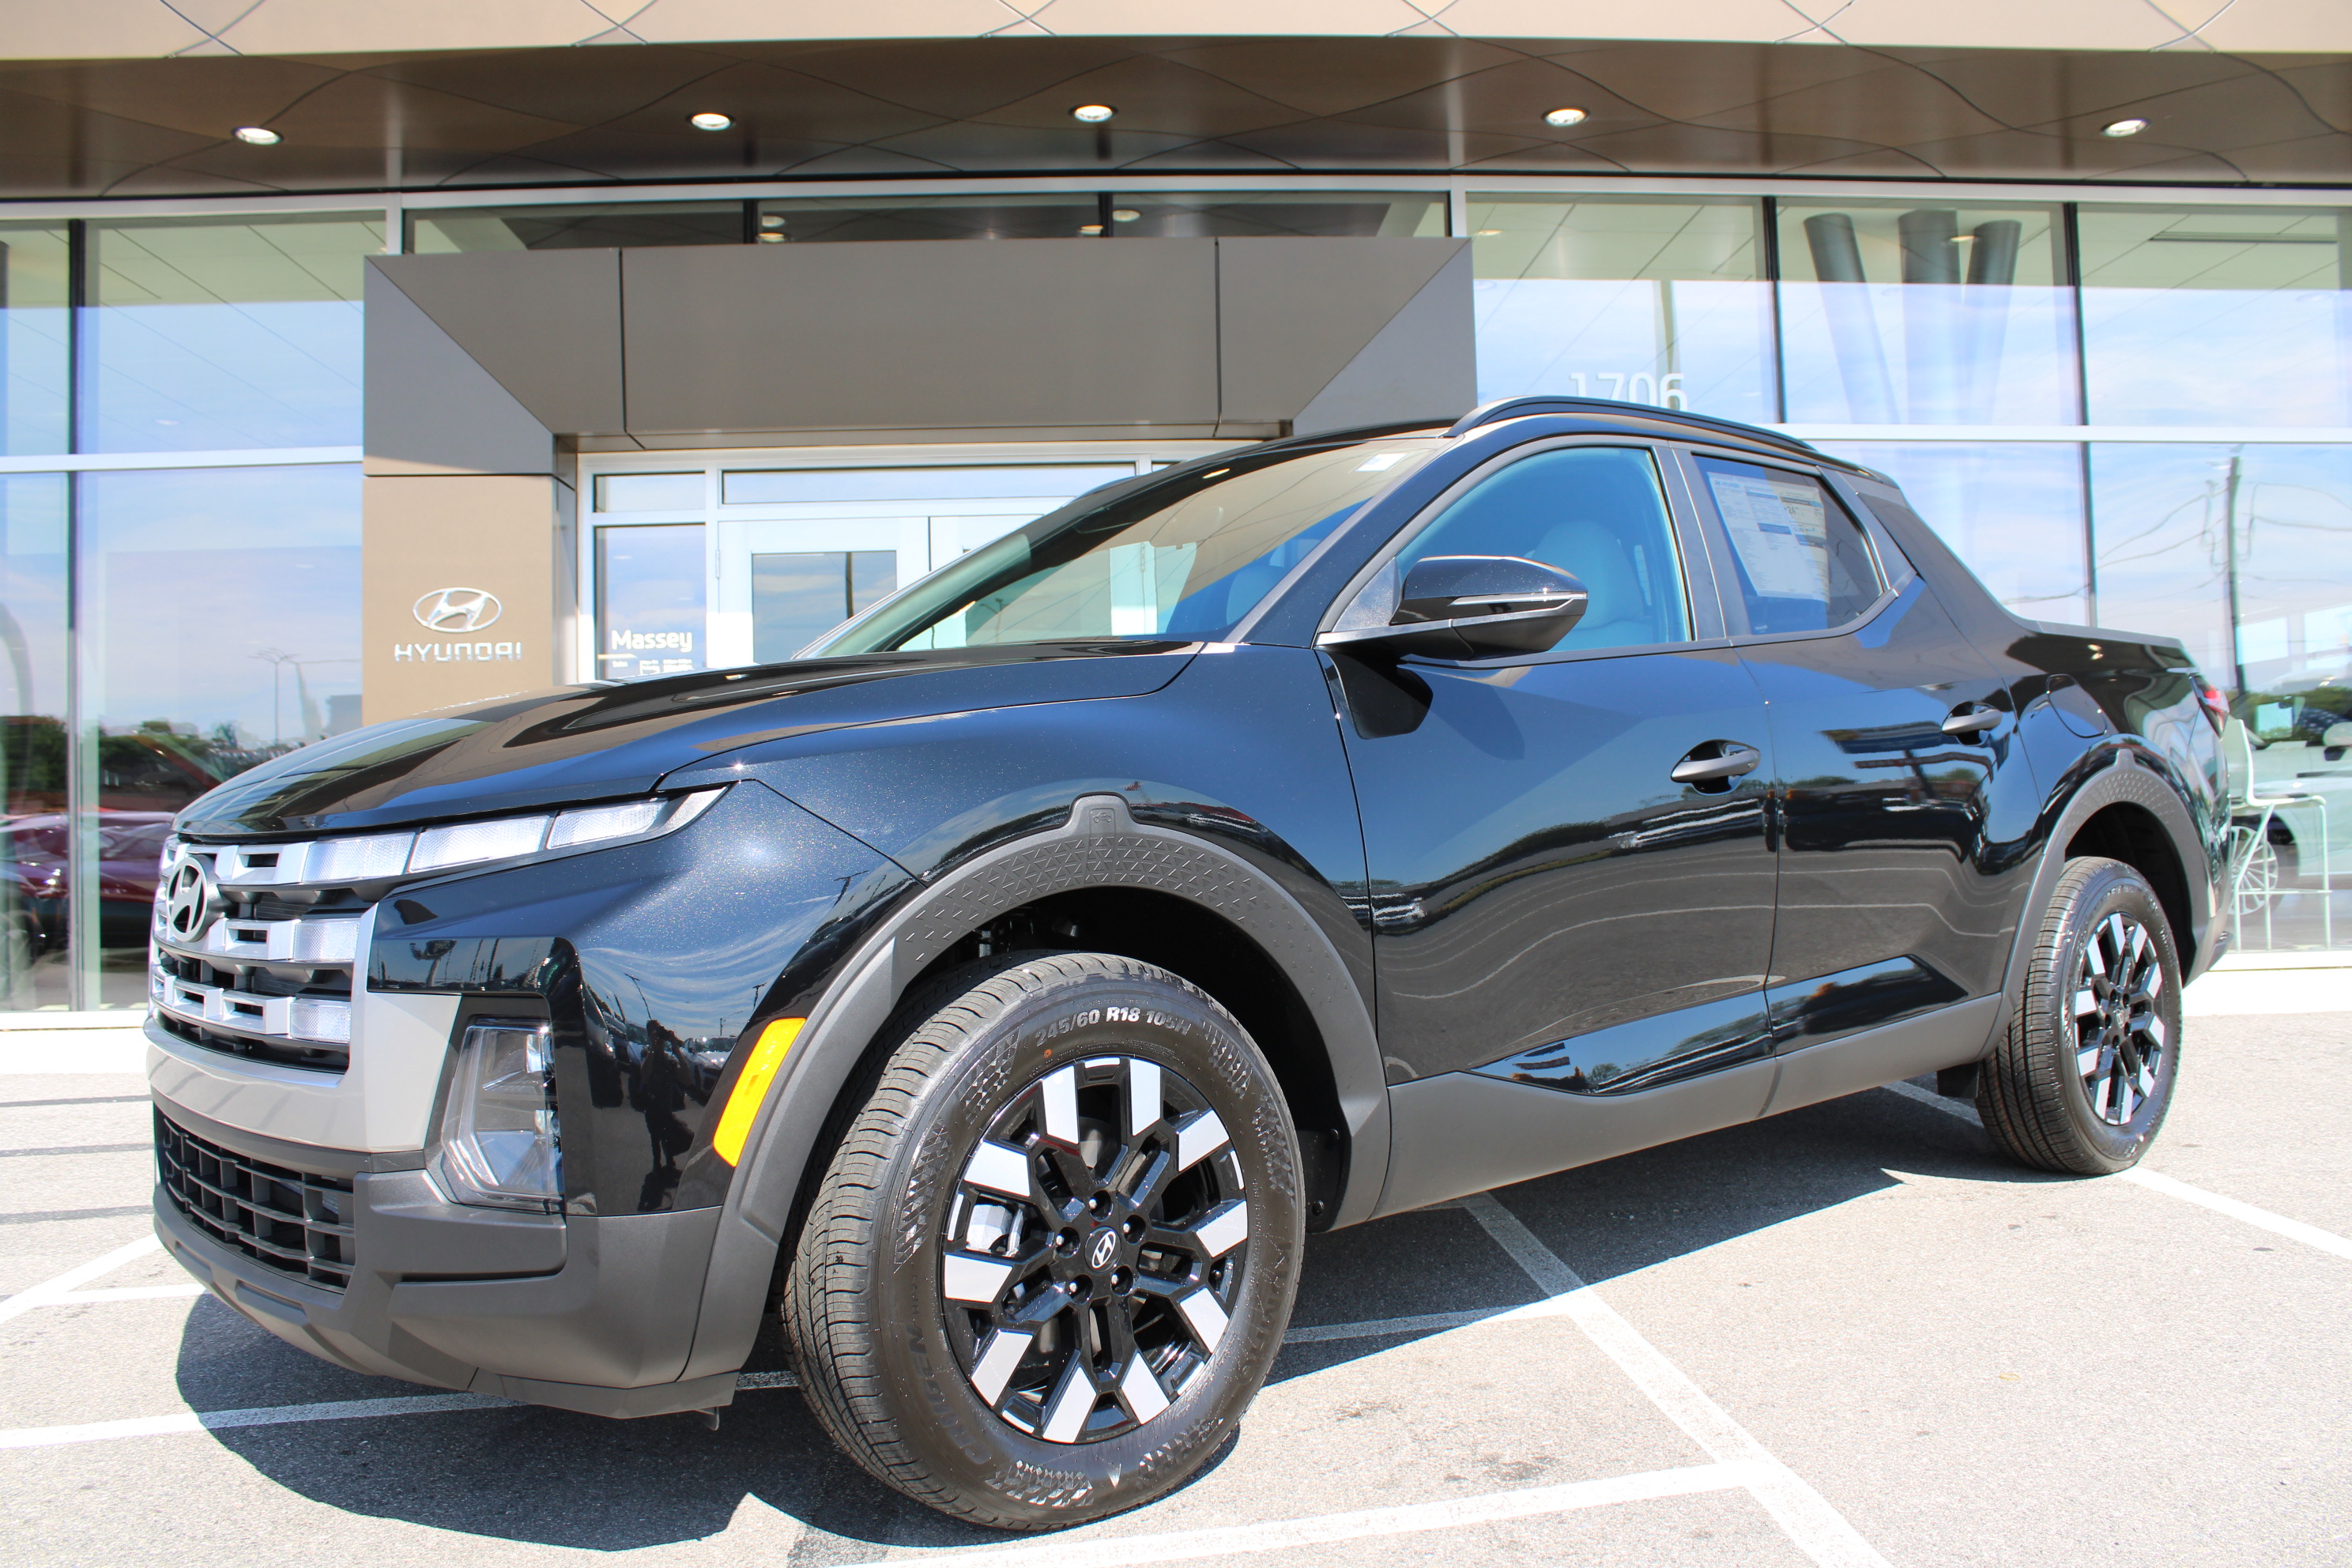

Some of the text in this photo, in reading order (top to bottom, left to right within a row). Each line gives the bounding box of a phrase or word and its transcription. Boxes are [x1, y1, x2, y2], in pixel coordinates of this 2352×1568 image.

[1570, 371, 1688, 412] 1706
[394, 642, 522, 662] HYUNDAI
[611, 629, 693, 653] Massey
[1035, 1006, 1192, 1047] 245/60 R18 105H
[1238, 1242, 1291, 1385] KUMHO
[906, 1327, 992, 1464] CRUGEN
